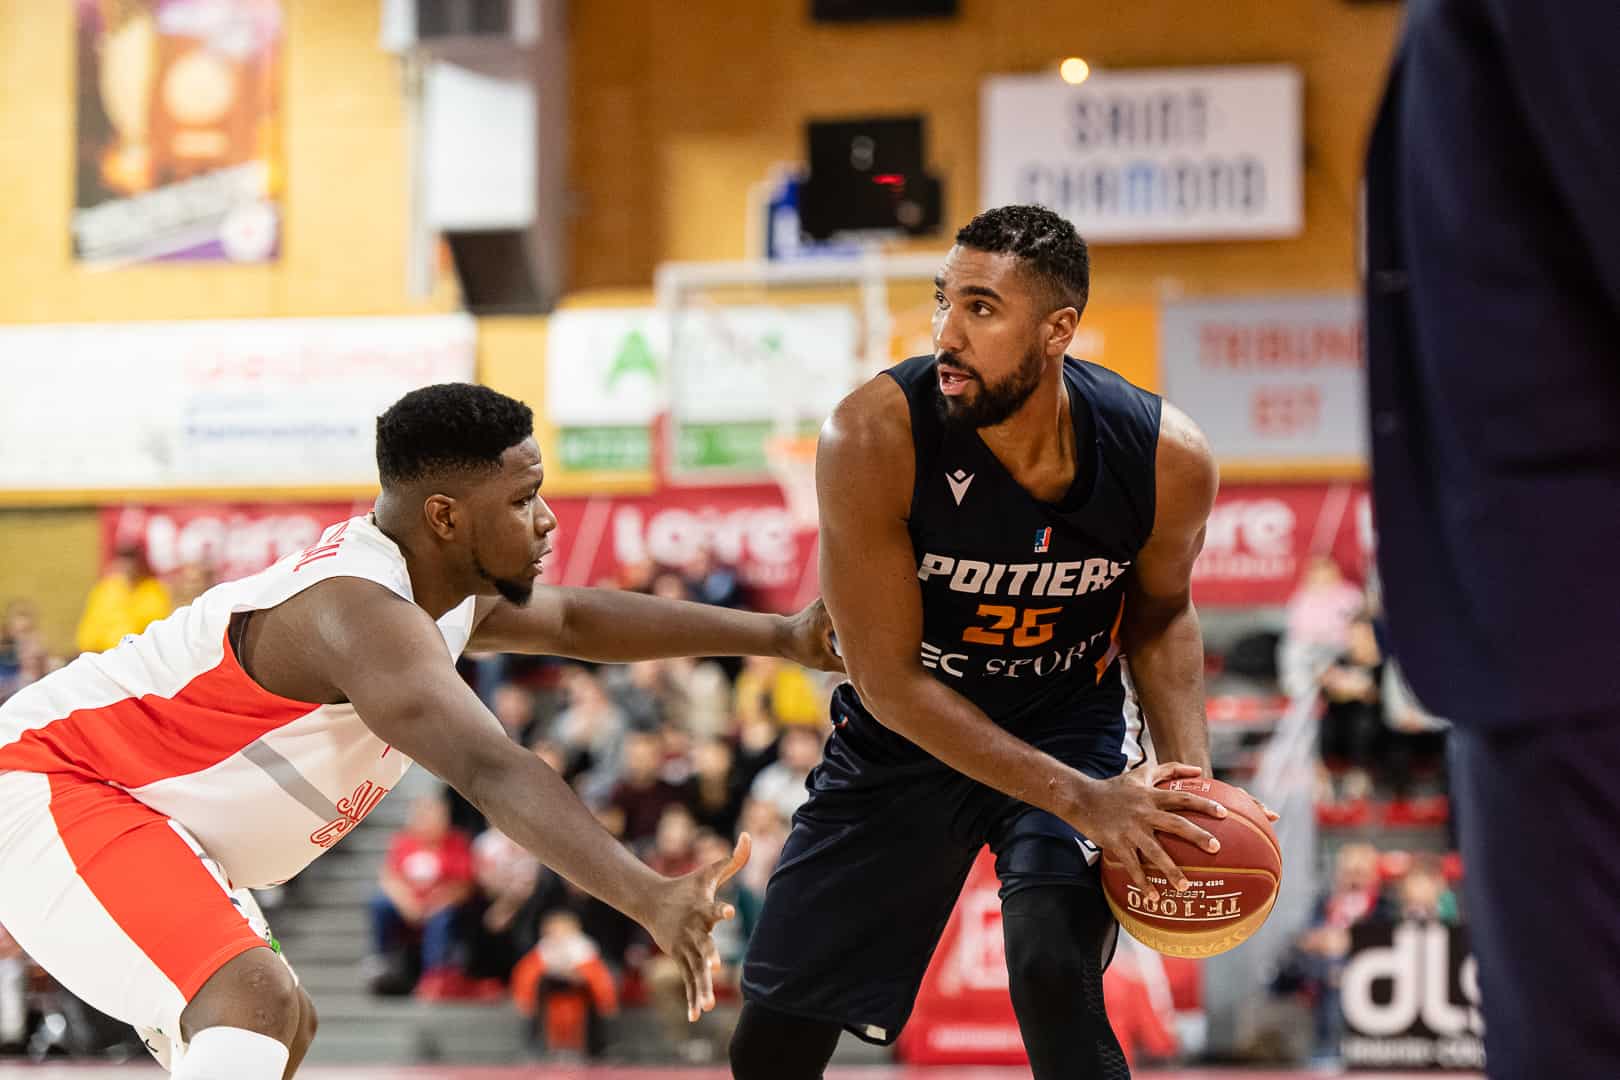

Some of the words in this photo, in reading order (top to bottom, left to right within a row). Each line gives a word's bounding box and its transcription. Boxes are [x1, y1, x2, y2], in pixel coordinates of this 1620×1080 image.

[1070, 88, 1210, 148] SAINT
[917, 552, 1132, 597] POITIERS
[962, 604, 1063, 648] 26
[1127, 890, 1241, 918] TF-1000
[1161, 888, 1206, 899] LEGACY
